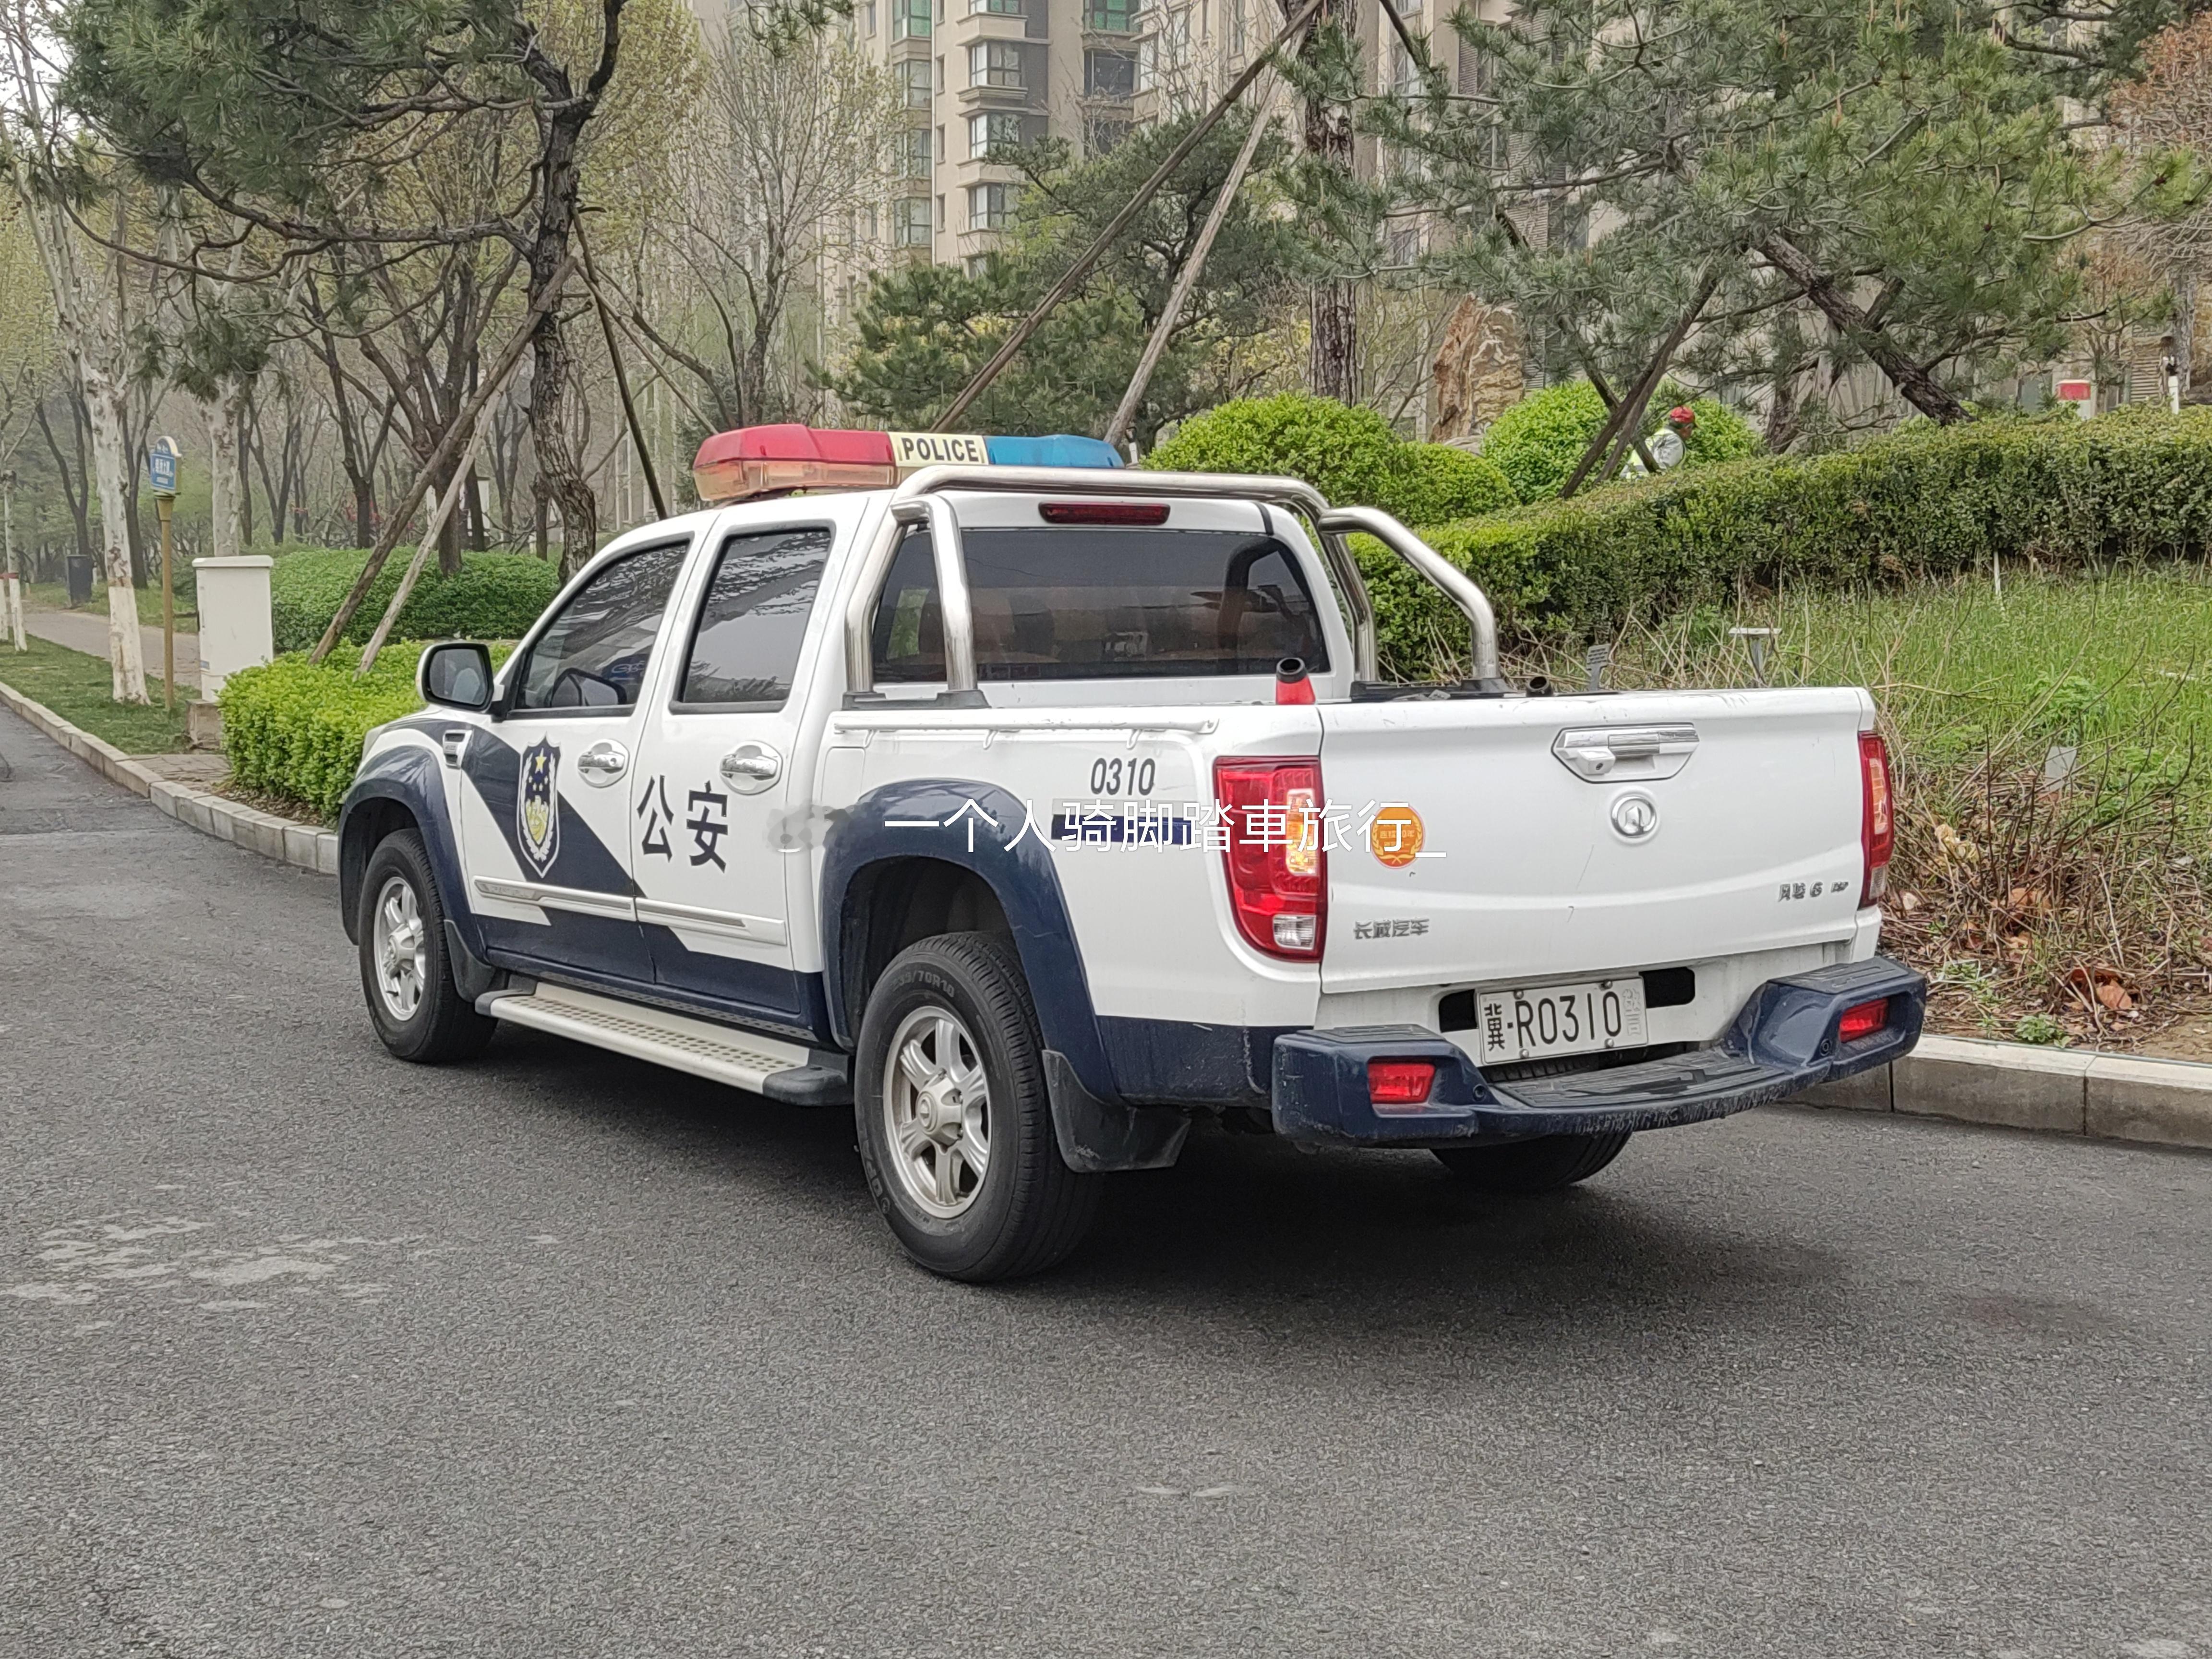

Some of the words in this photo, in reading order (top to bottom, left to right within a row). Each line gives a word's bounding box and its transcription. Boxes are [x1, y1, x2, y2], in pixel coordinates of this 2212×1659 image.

[901, 437, 979, 462] POLICE
[1091, 757, 1155, 795] 0310
[637, 774, 728, 873] 公安
[1353, 918, 1430, 939] 长城汽车
